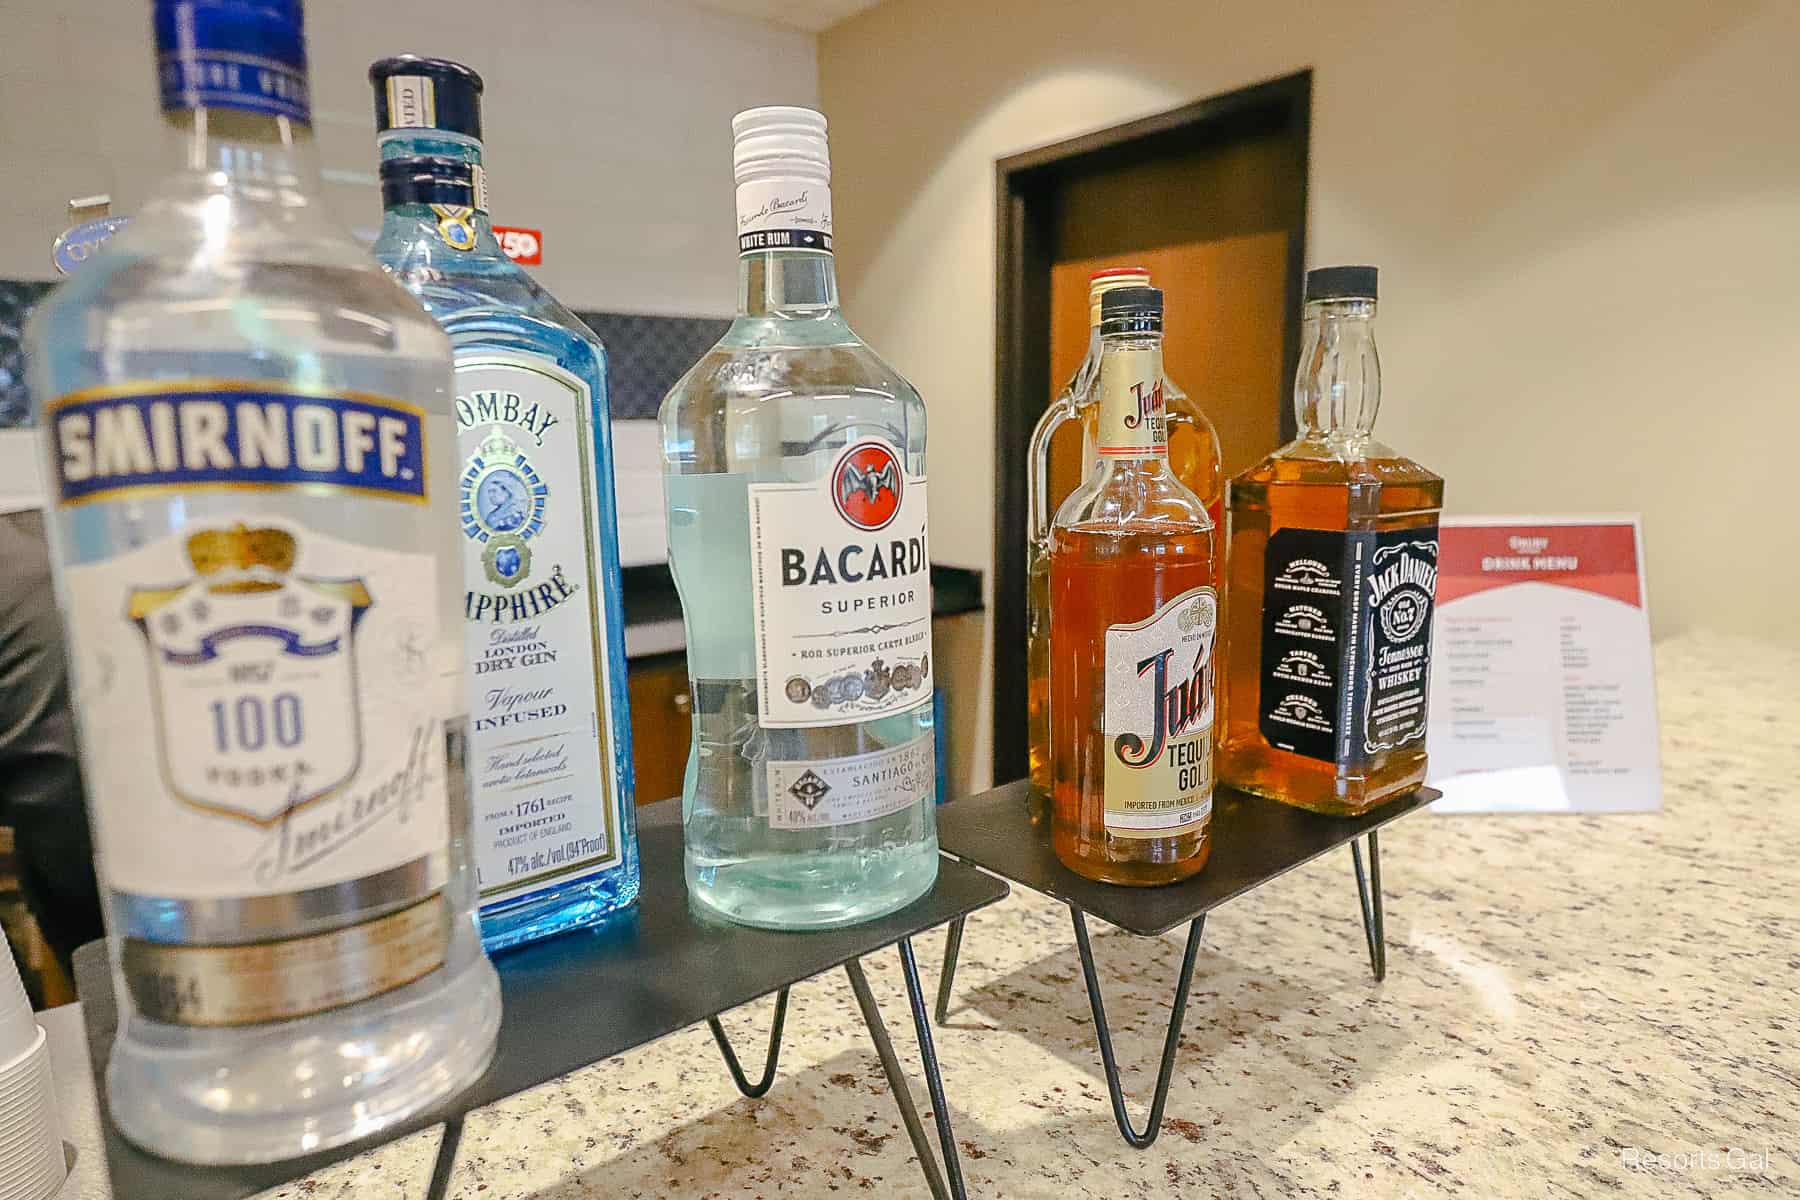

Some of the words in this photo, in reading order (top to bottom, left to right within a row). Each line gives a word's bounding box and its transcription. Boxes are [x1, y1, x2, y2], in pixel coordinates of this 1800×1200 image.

[767, 231, 790, 246] RUM
[456, 393, 558, 447] OMBAY
[781, 523, 926, 587] BACARDÍ
[1481, 556, 1531, 572] DRINK
[1533, 556, 1579, 571] MENU
[1367, 562, 1400, 607] JACK
[821, 590, 915, 614] SUPERIOR
[485, 641, 548, 659] LONDON
[800, 650, 823, 659] RON
[826, 643, 876, 657] SUPERIOR
[475, 657, 516, 675] DRY
[520, 650, 558, 667] GIN
[1378, 666, 1422, 690] WHISKEY
[485, 688, 554, 711] Vapour
[210, 693, 304, 752] 100
[474, 704, 567, 731] INFUSED
[852, 761, 914, 788] SANTIAGO
[516, 798, 545, 817] 1761
[1124, 800, 1157, 810] IMPORTED
[1158, 799, 1175, 809] FROM
[498, 813, 566, 836] IMPORTED
